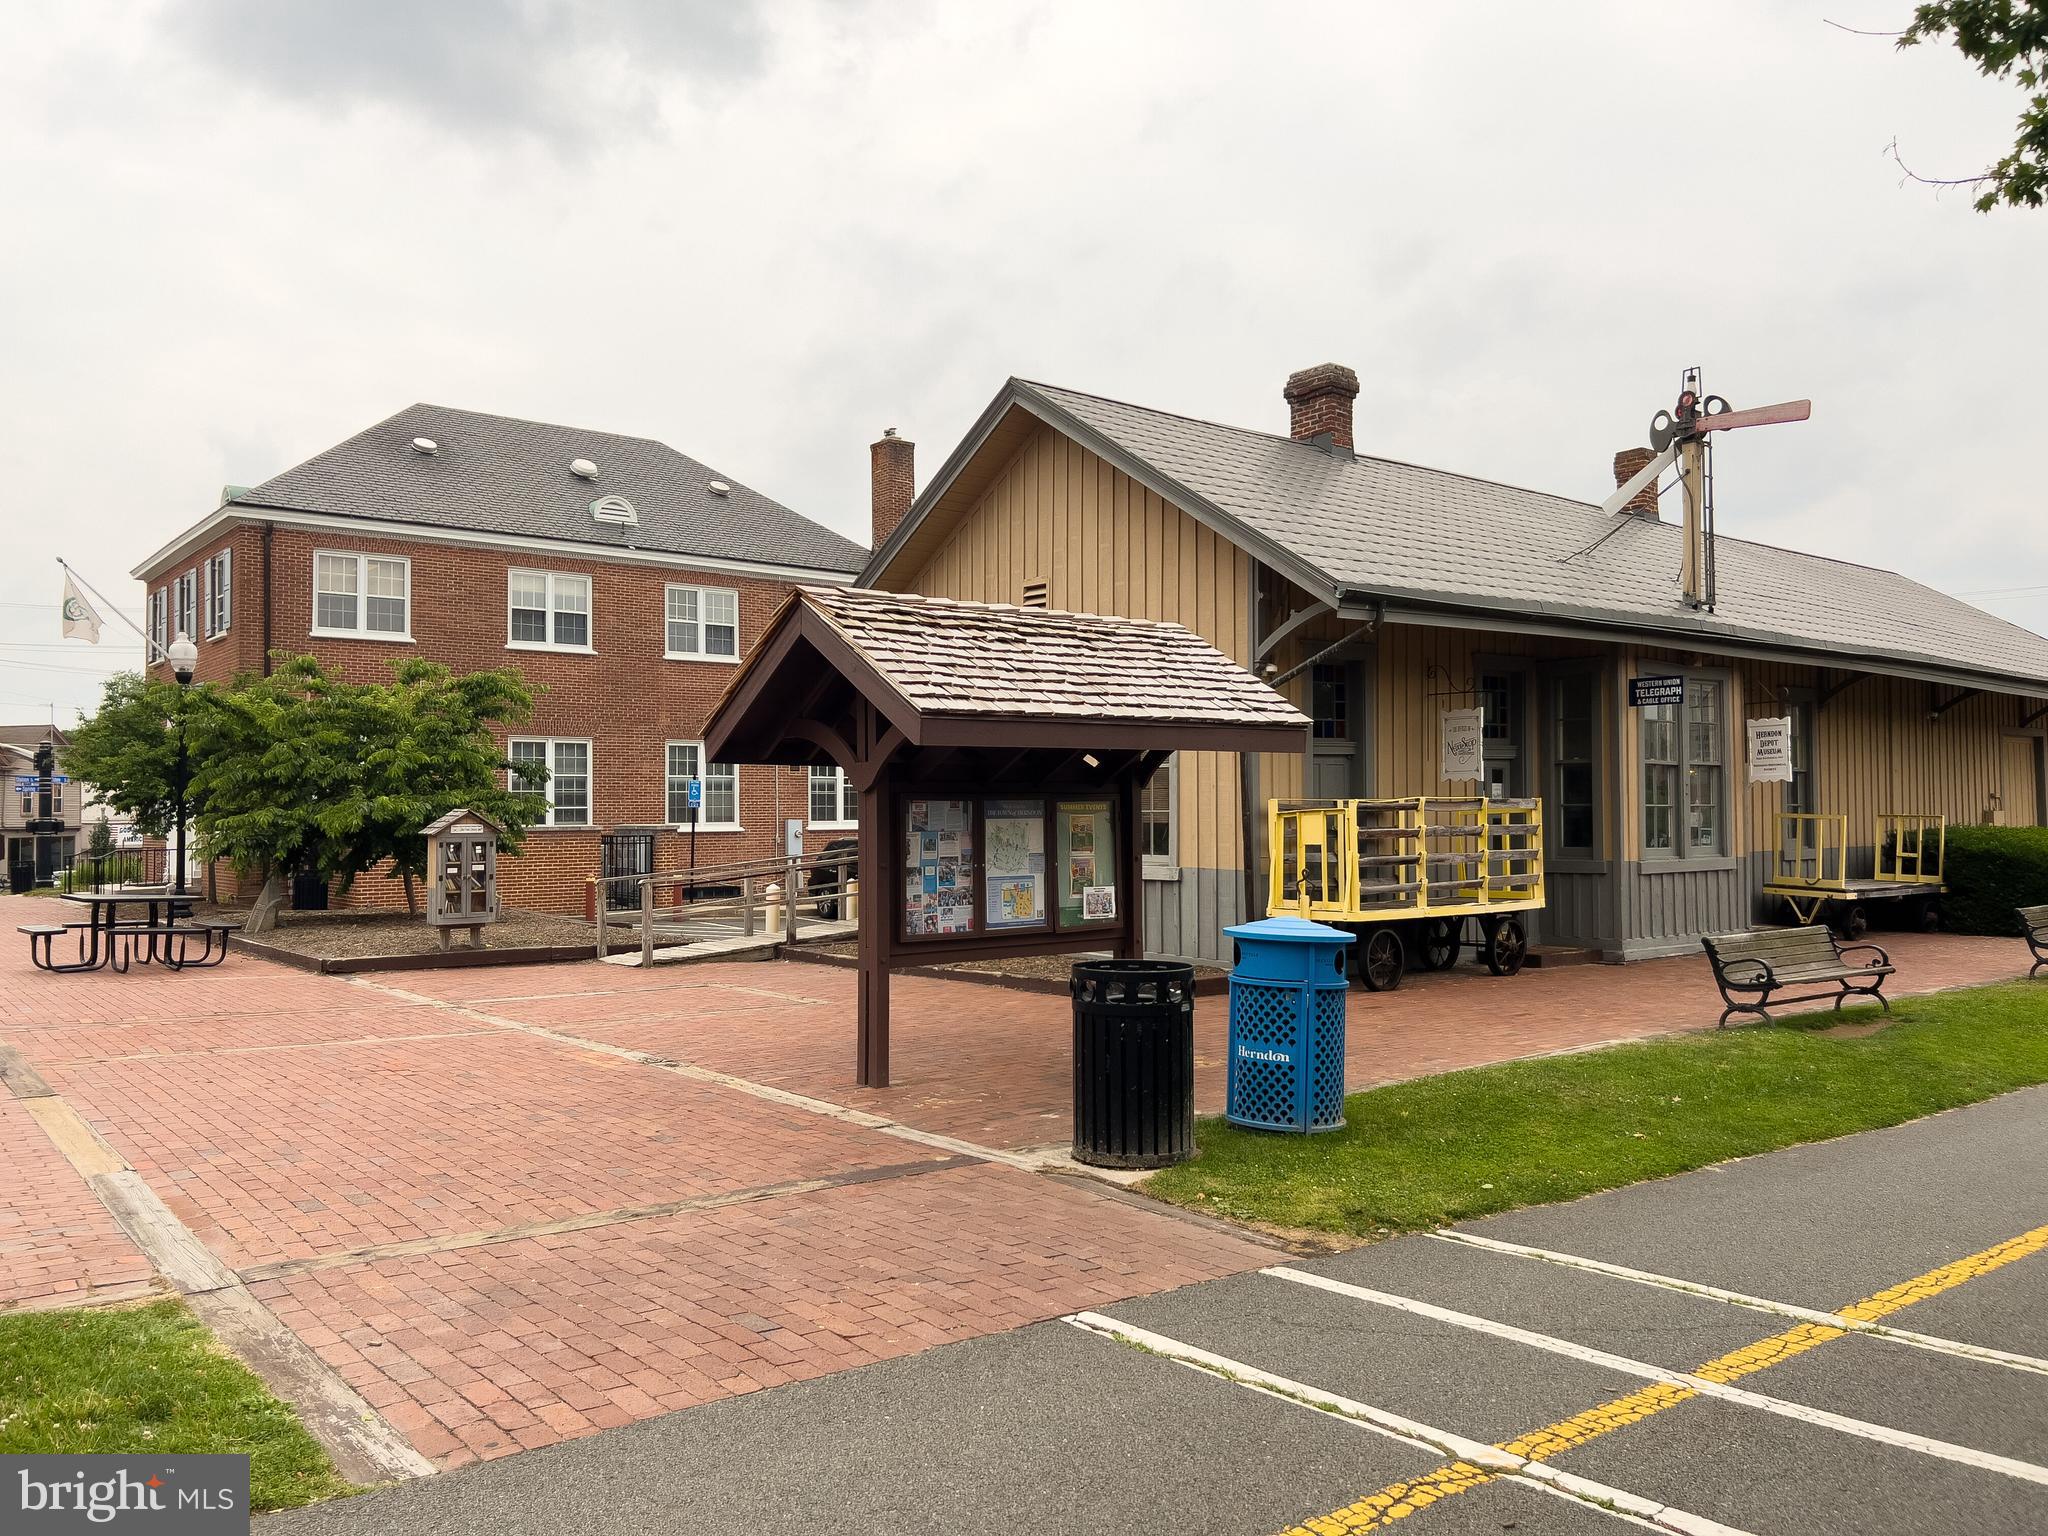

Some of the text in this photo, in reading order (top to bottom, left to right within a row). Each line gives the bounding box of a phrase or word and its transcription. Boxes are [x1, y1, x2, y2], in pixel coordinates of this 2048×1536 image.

[1637, 678, 1681, 688] WESTERN UNION
[1635, 686, 1682, 697] TELEGRAPH
[1756, 730, 1782, 739] HERNDON
[1760, 739, 1779, 748] DEPOT
[1757, 748, 1782, 756] MUSEUM
[1238, 1044, 1290, 1062] Herndon
